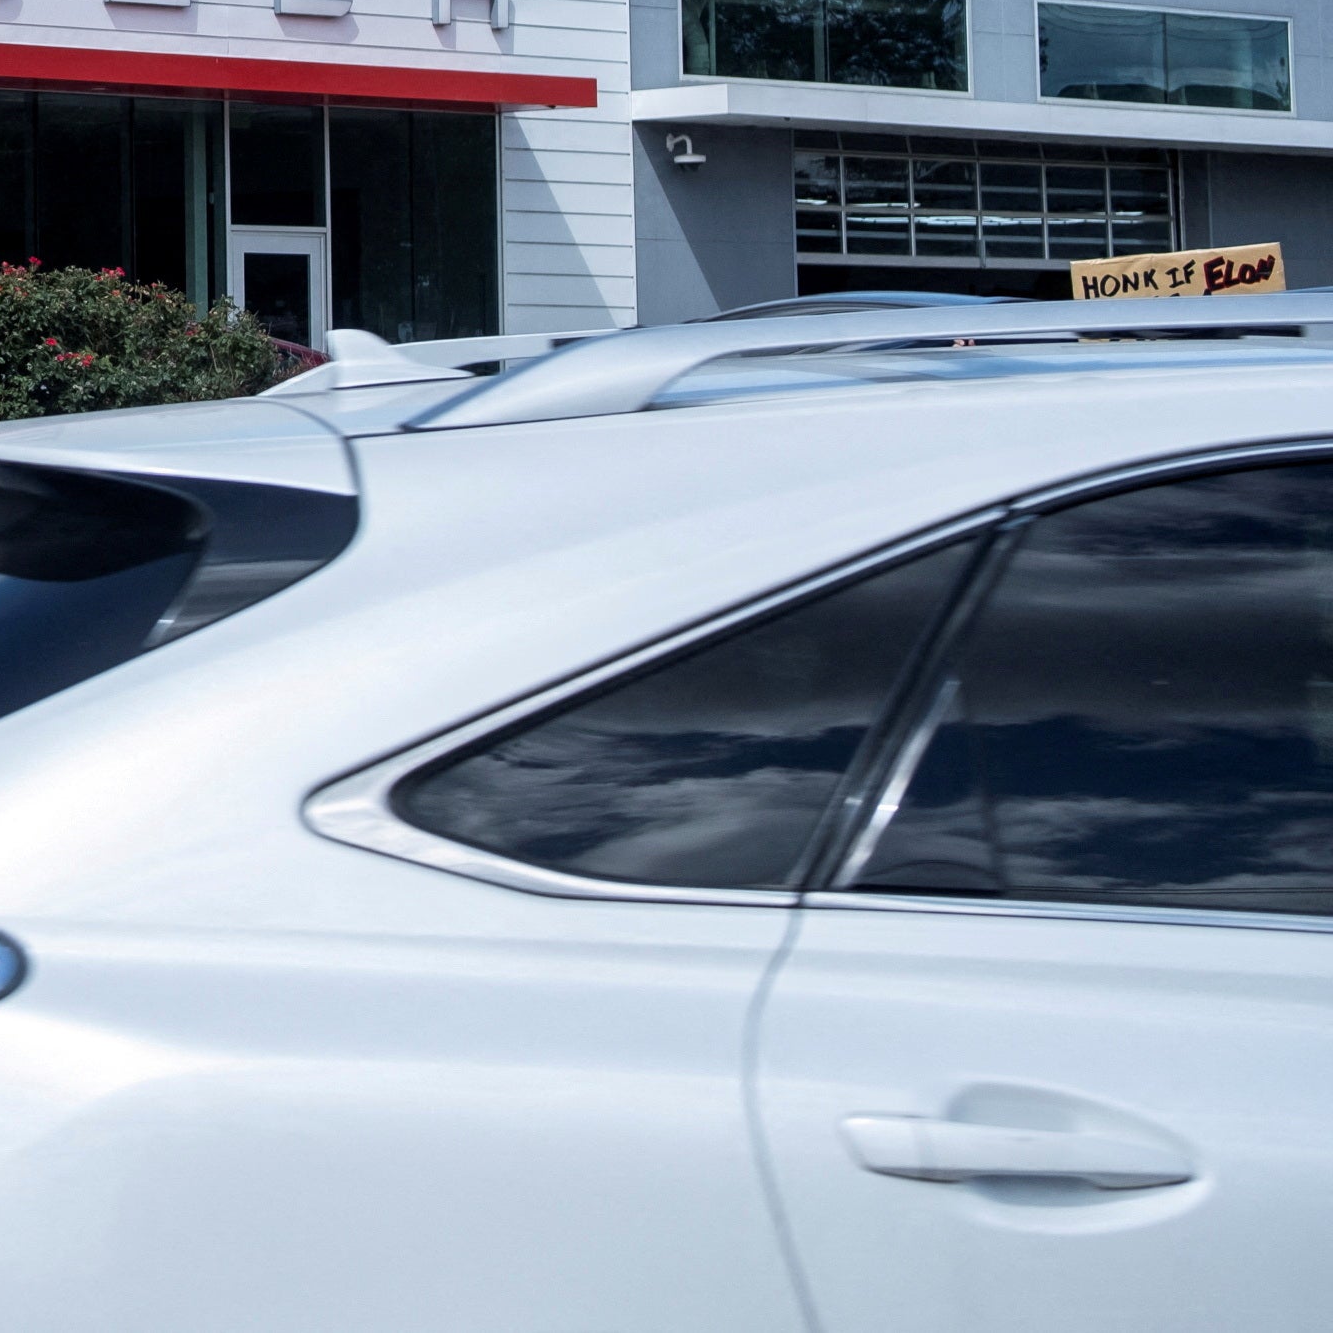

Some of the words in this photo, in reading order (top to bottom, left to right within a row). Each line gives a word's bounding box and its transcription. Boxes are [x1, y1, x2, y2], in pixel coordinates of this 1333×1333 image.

[1082, 268, 1159, 300] HONK
[1165, 259, 1195, 289] IF
[1203, 255, 1276, 292] ELON
